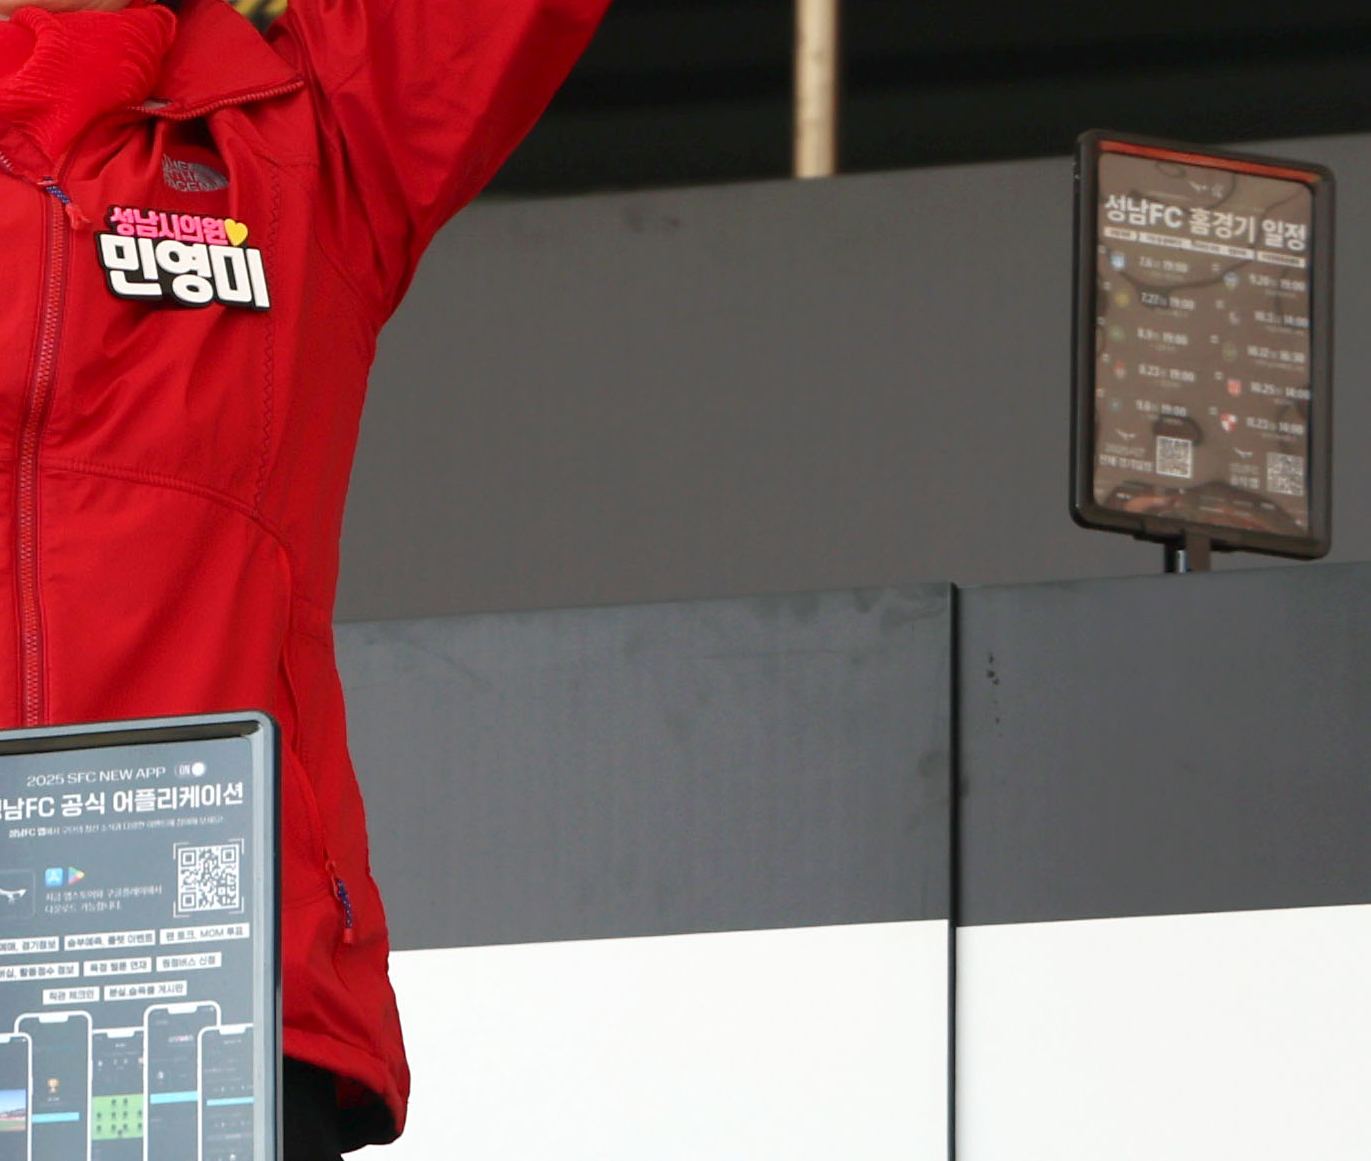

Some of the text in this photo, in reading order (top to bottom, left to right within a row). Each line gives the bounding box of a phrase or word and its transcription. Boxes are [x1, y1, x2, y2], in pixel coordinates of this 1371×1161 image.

[109, 206, 229, 245] 성남시의원
[1104, 193, 1182, 229] 성남FC
[1188, 206, 1256, 244] 홈경기
[1261, 219, 1307, 252] 일정
[99, 233, 271, 308] 민영미
[26, 764, 191, 788] 2025 SFC NEW APP ON
[61, 793, 106, 818] 공식
[112, 782, 244, 814] 어플리케이션
